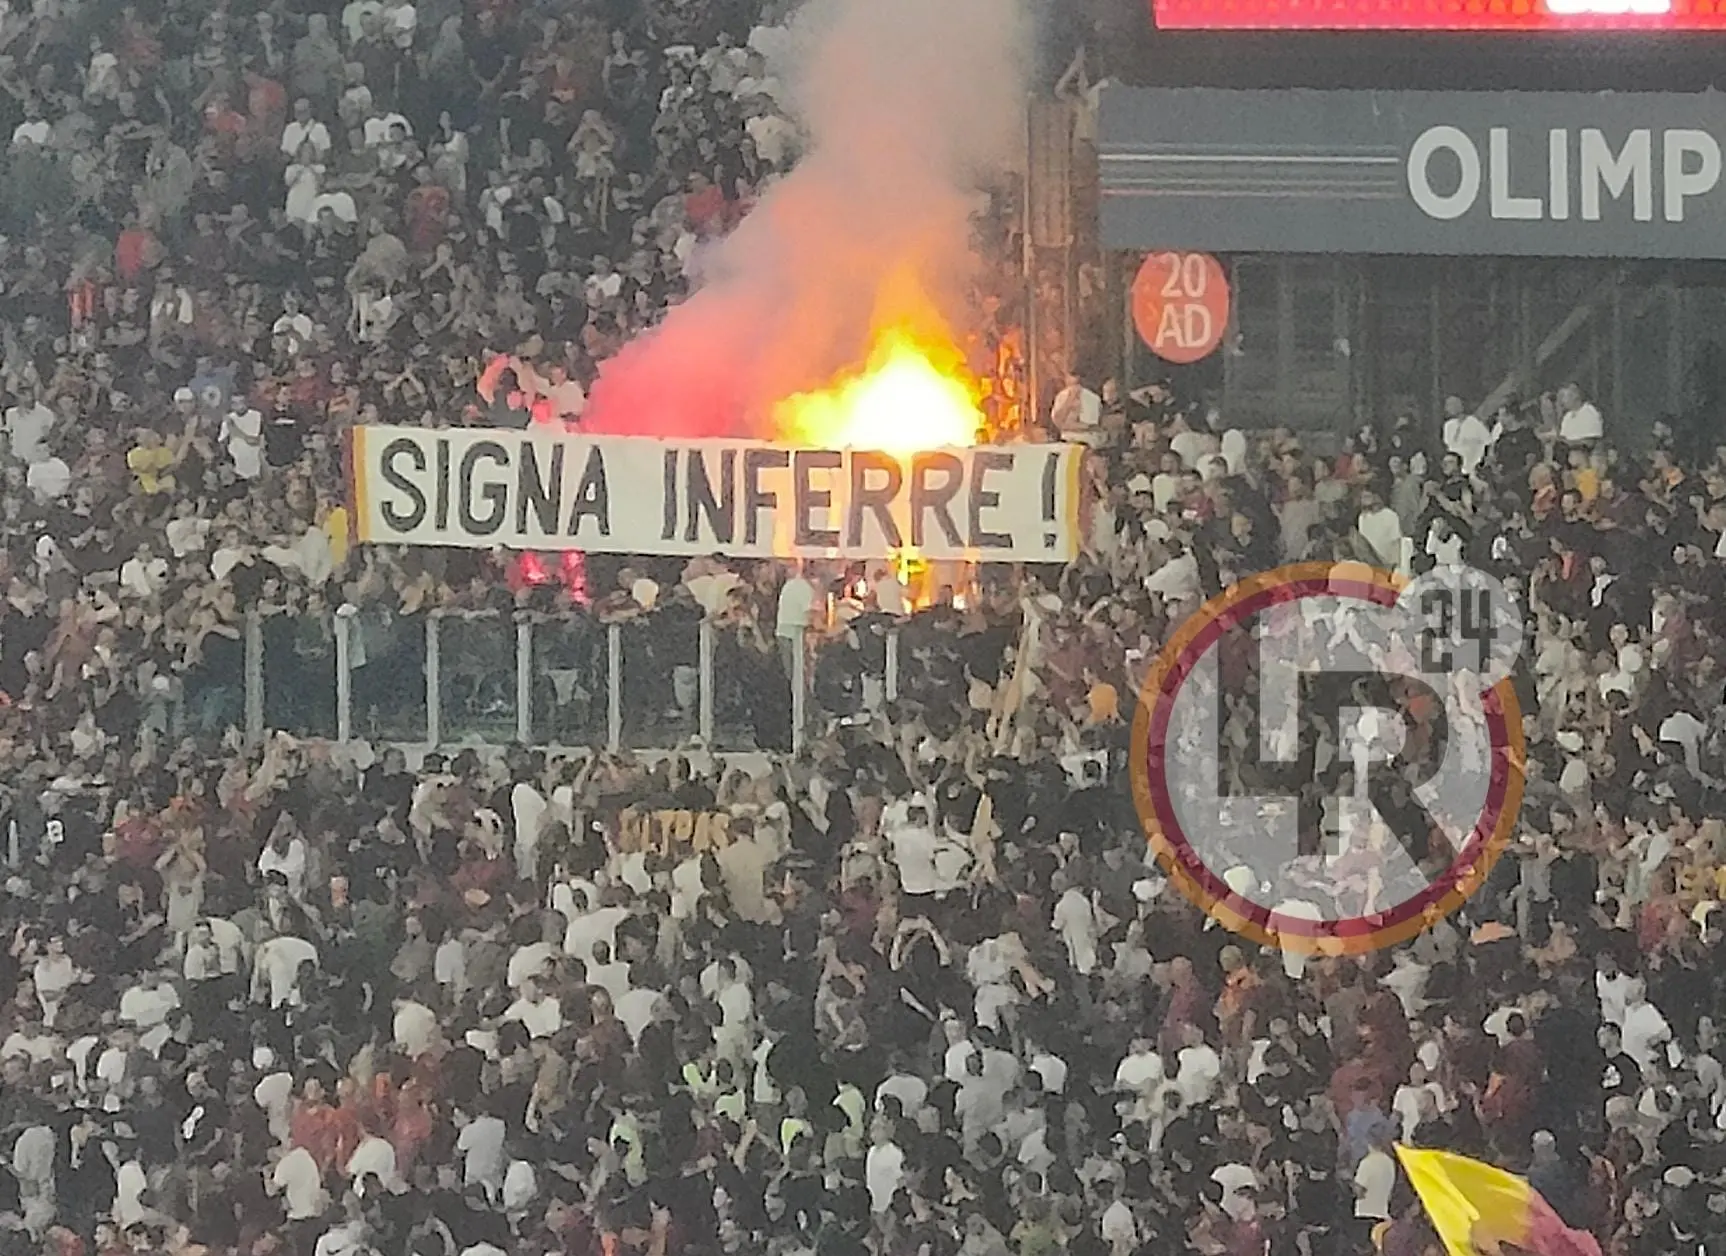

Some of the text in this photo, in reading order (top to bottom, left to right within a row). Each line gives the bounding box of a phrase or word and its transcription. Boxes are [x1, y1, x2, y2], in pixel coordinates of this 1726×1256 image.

[1161, 252, 1206, 297] 20
[1156, 303, 1211, 348] AD
[381, 437, 1060, 551] SIGNA INFERRE !
